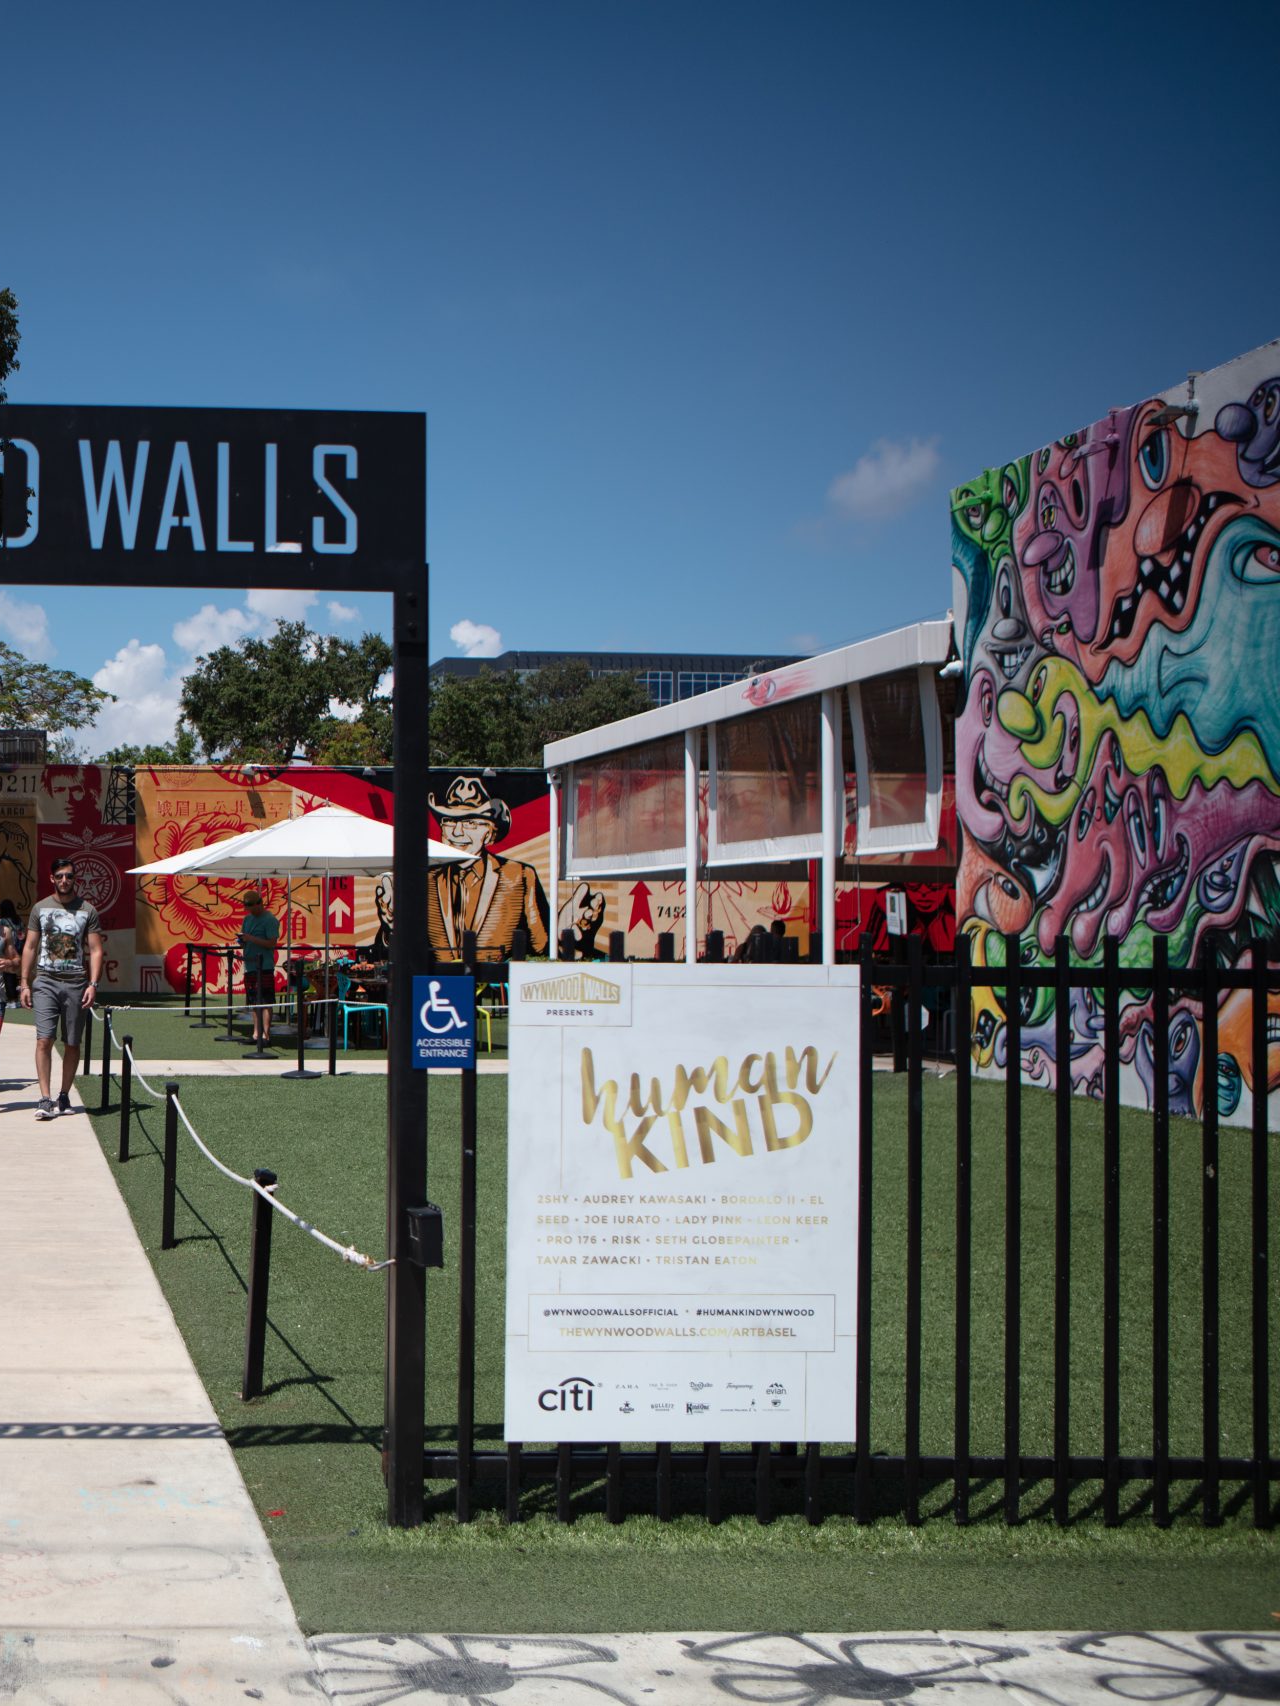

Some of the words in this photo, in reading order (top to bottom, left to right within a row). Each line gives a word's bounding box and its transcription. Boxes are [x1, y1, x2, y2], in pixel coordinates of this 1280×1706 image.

[78, 438, 358, 555] WALLS
[522, 977, 580, 1001] WYNWOOD
[583, 976, 619, 1001] WALLS
[416, 1038, 471, 1049] ACCESSIBLE
[419, 1048, 468, 1059] ENTRANCE
[580, 1045, 839, 1132] human
[613, 1090, 814, 1180] KIND
[537, 1195, 568, 1204] 2SHY
[583, 1195, 634, 1204] AUDREY
[639, 1195, 706, 1204] KAWASAKI
[721, 1195, 783, 1204] BORDALO
[809, 1195, 824, 1204] EL
[537, 1215, 569, 1225] SEED
[584, 1215, 609, 1225] JOE
[613, 1215, 661, 1225] IURATO
[675, 1215, 708, 1225] LADY
[712, 1215, 743, 1225] PINK
[757, 1215, 791, 1225] LEON
[796, 1215, 829, 1225] KEER
[546, 1235, 572, 1245] PRO
[577, 1235, 597, 1245] 176
[612, 1235, 641, 1245] RISK
[655, 1235, 687, 1245] SETH
[692, 1235, 789, 1245] GLOBEPAINTER
[537, 1255, 577, 1265] TAVAR
[582, 1255, 641, 1265] ZAWACKI
[656, 1255, 709, 1265] TRISTAN
[714, 1255, 758, 1265] EATON
[543, 1308, 679, 1317] @WYNWOODWALLSOFFICIAL
[696, 1308, 815, 1317] #HUMANKINDWYNWOOD
[559, 1327, 796, 1337] THEWYNWOODWALLS.COM/ARTBASEL
[538, 1382, 594, 1411] citi
